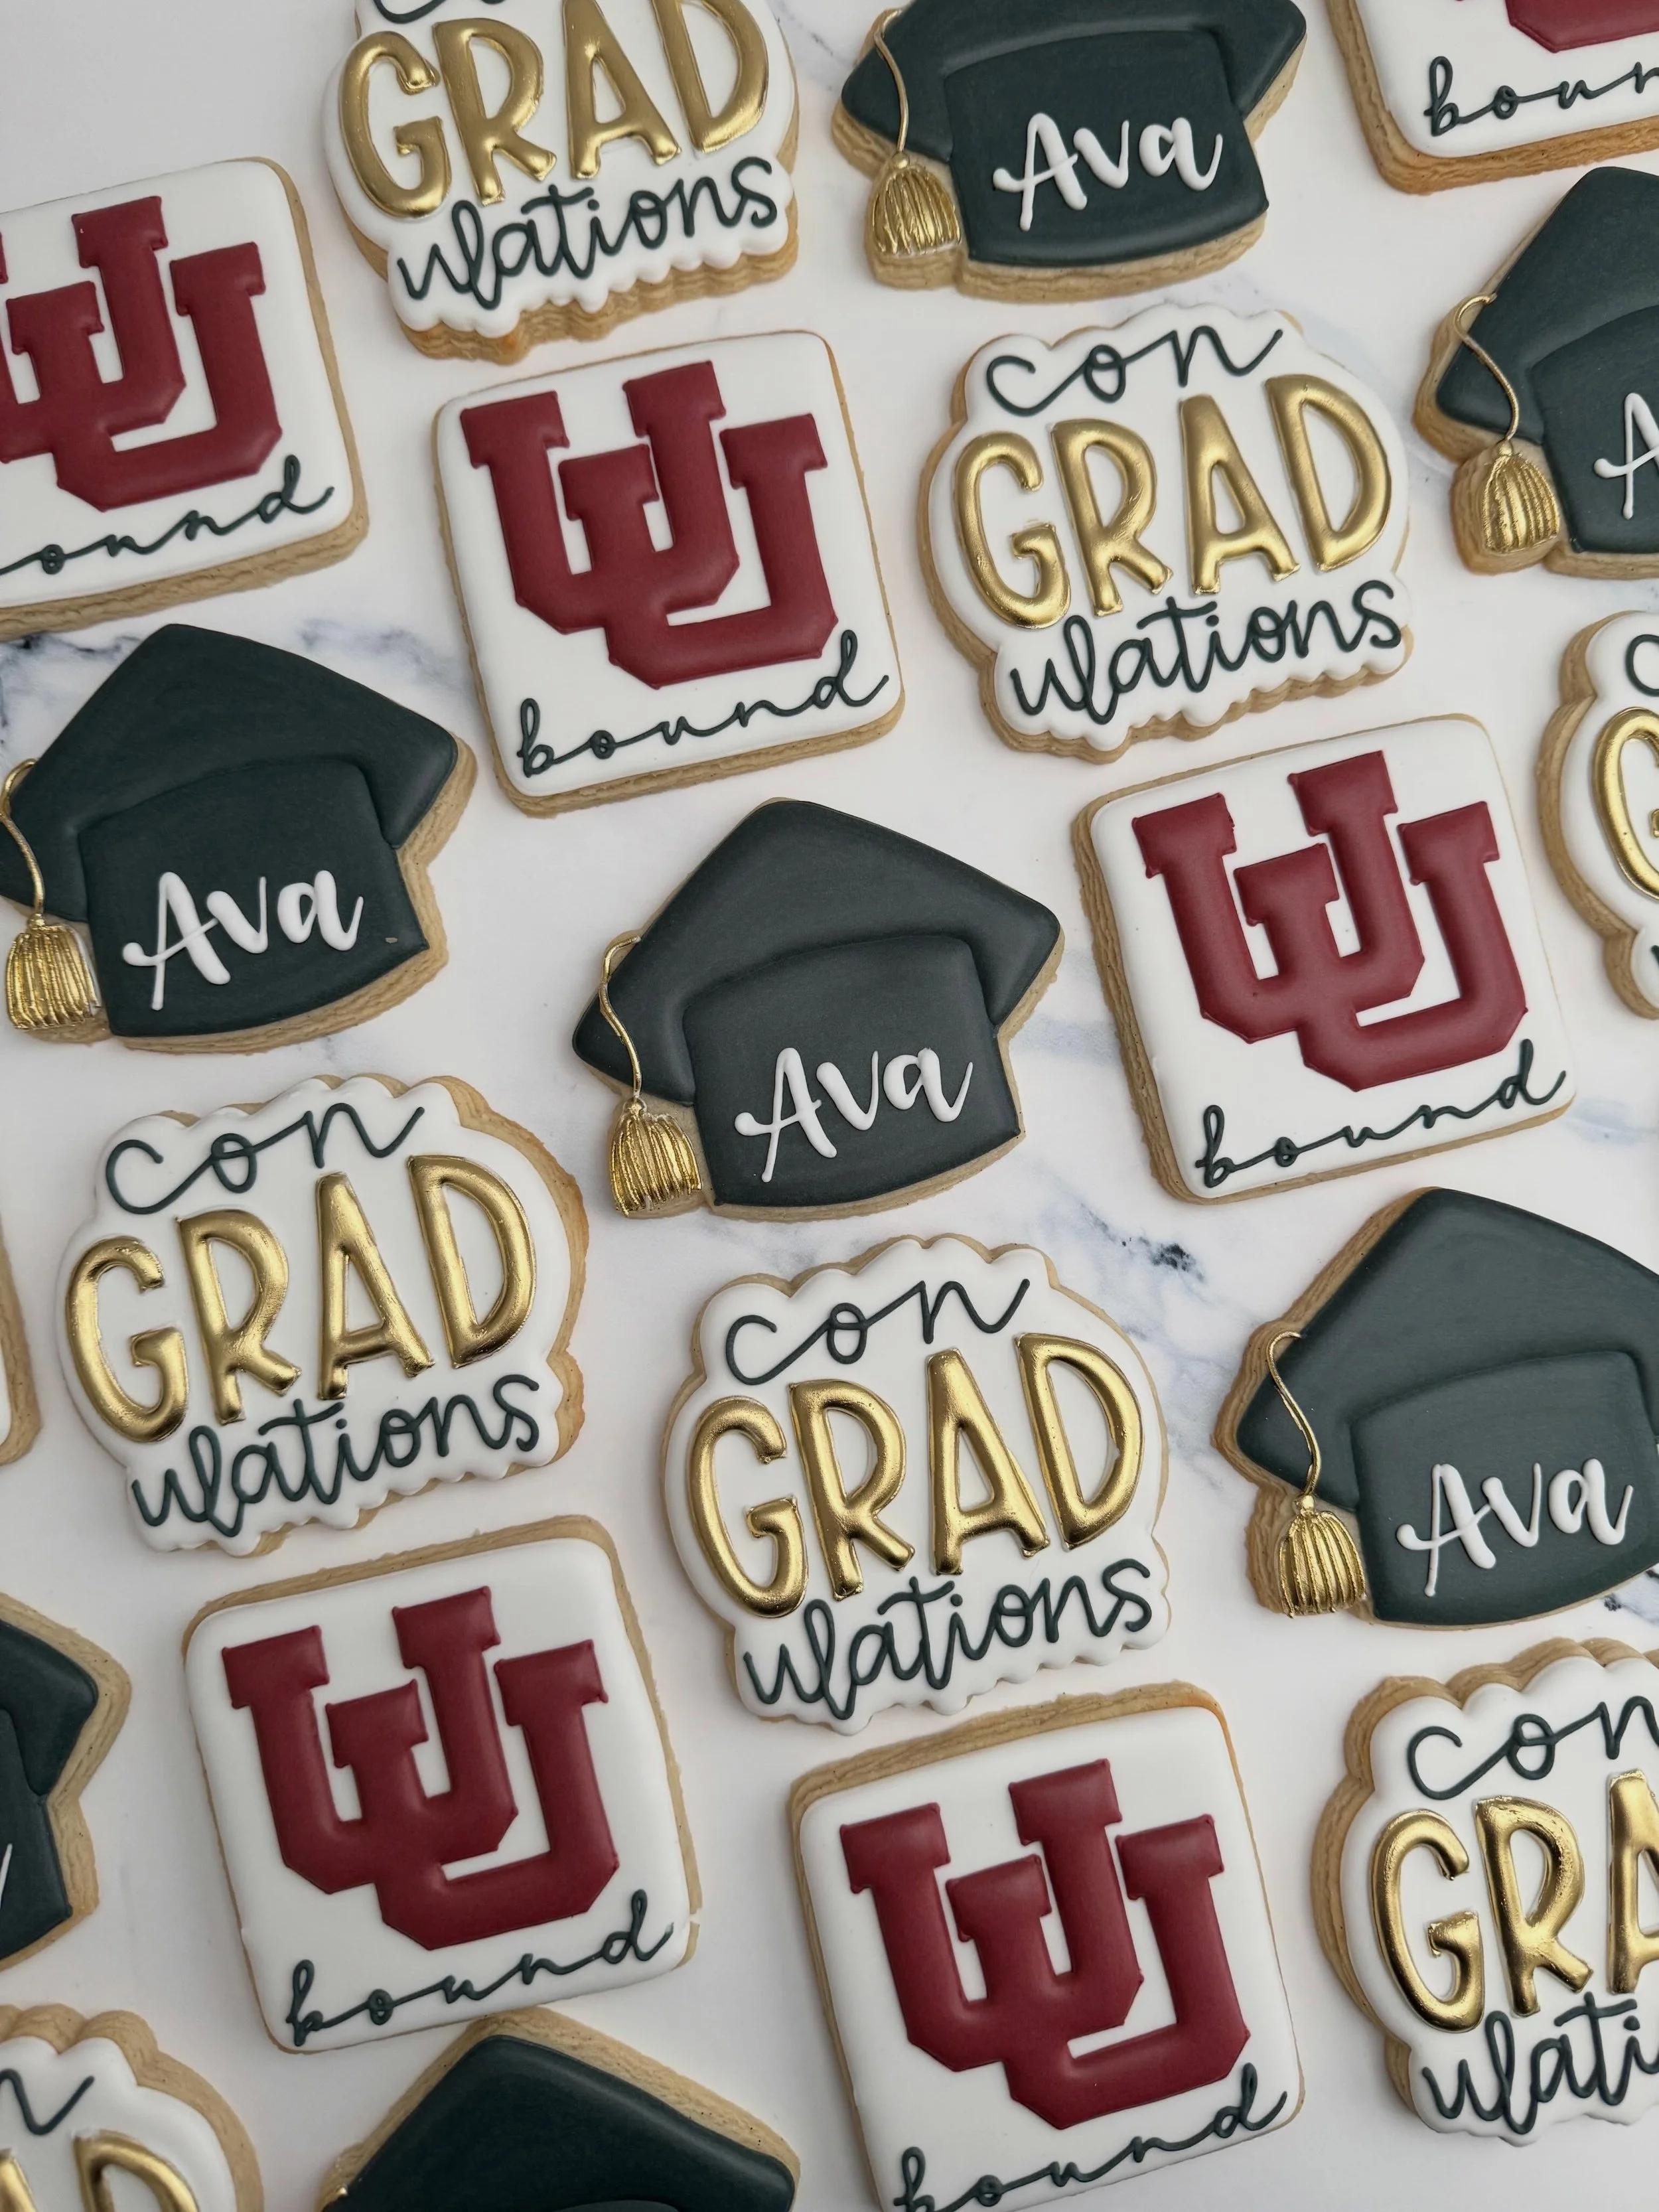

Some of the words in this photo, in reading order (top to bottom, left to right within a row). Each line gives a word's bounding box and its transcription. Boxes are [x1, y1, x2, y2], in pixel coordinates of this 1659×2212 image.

[338, 0, 769, 219] GRAD
[993, 112, 1223, 230] Ava
[1423, 56, 1659, 137] boun
[397, 157, 778, 310] ulations
[986, 325, 1283, 417] con
[0, 454, 334, 575] ound
[953, 373, 1393, 630] GRAD
[516, 629, 889, 778] bound
[1010, 580, 1402, 725] ulations
[123, 870, 364, 1011] Ava
[105, 1102, 425, 1215] con
[734, 1047, 974, 1183] Ava
[1194, 1039, 1566, 1189] bound
[65, 1154, 538, 1443] GRAD
[724, 1278, 1031, 1386] con
[131, 1374, 540, 1538] ulations
[687, 1333, 1145, 1618] GRAD
[1396, 1458, 1634, 1597] Ava
[742, 1558, 1152, 1720] ulations
[284, 1889, 674, 2047] bound
[1370, 1769, 1659, 2033] GRA
[893, 2063, 1288, 2212] bound
[1421, 1991, 1659, 2135] ulati
